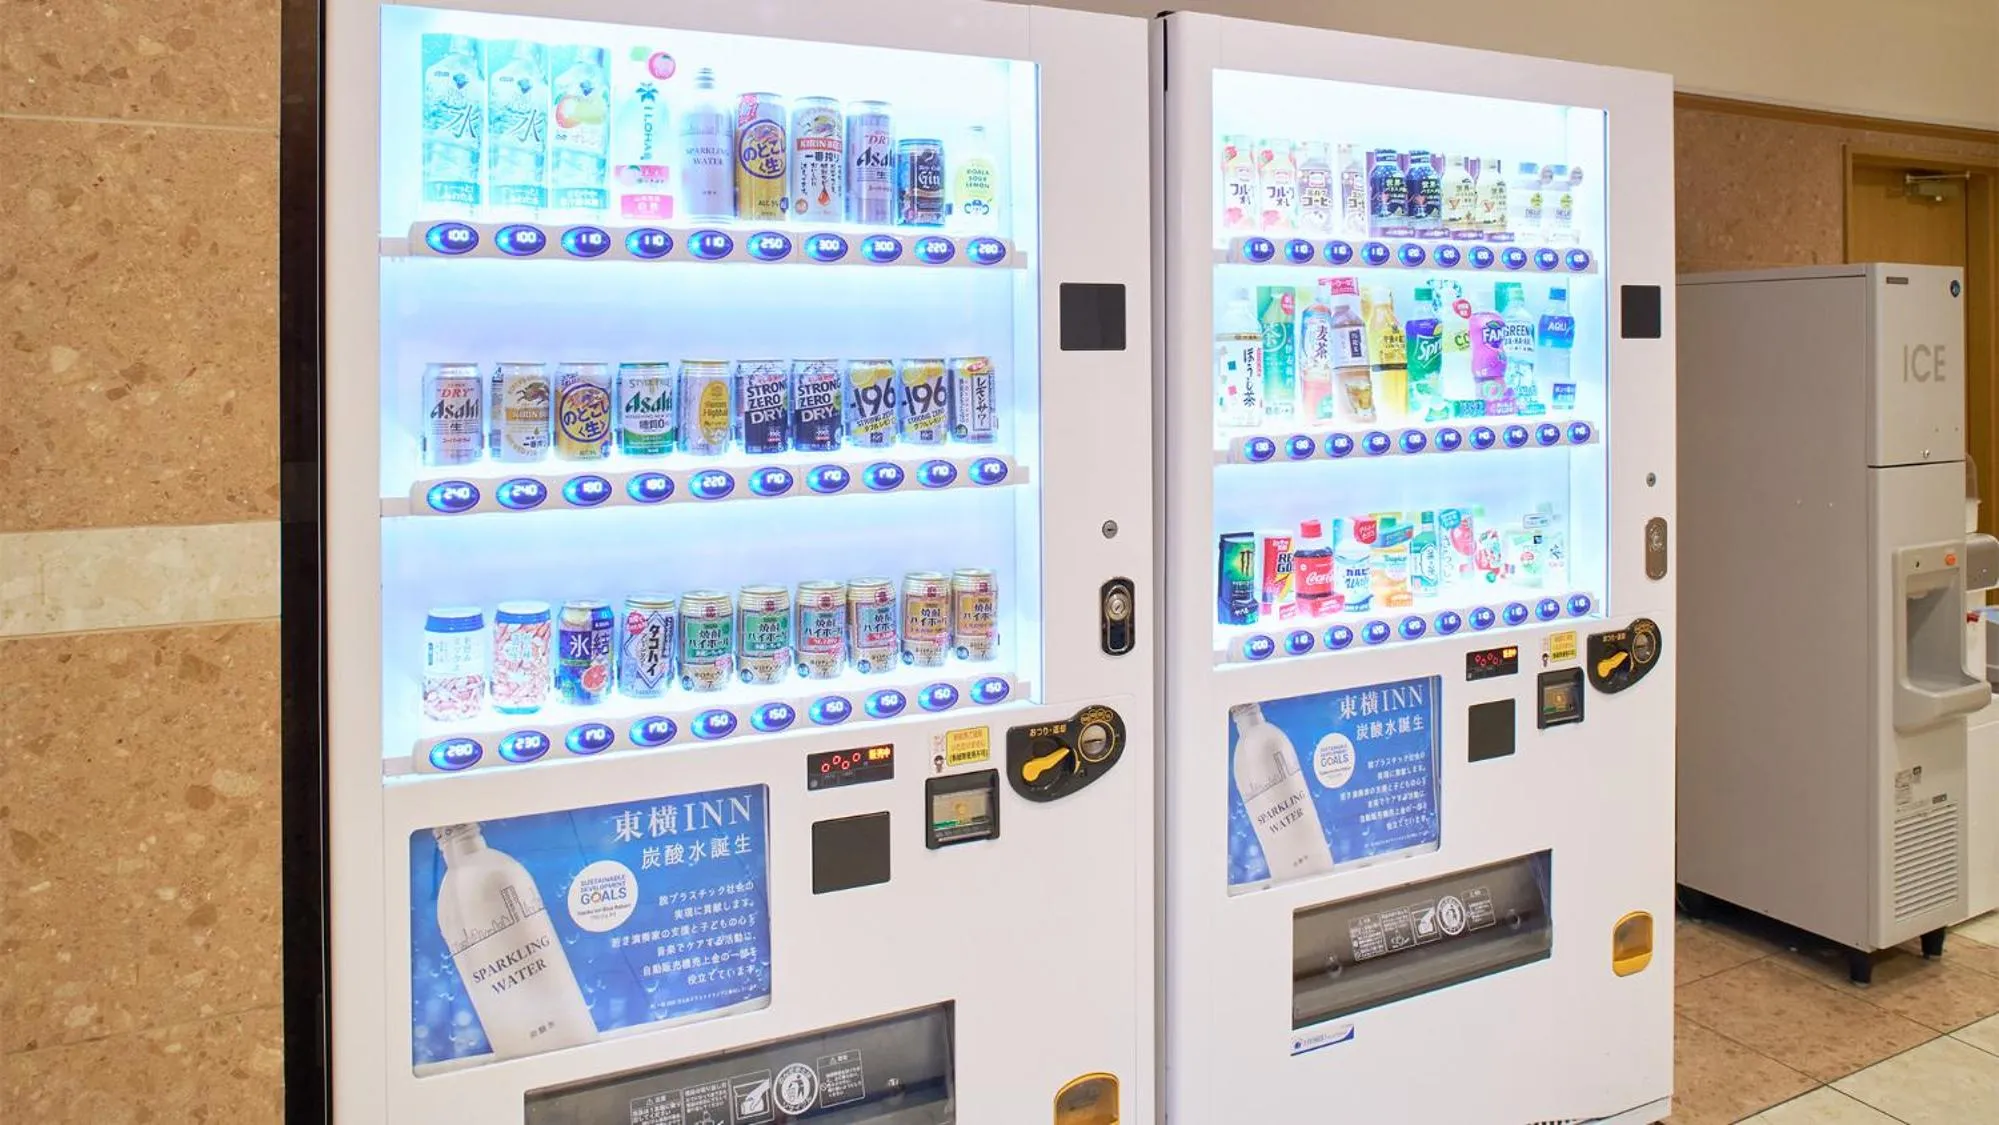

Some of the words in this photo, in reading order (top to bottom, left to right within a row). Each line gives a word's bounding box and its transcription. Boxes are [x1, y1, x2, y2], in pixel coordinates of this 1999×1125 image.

[1903, 343, 1947, 383] ICE
[430, 399, 480, 419] Asahi
[748, 393, 781, 410] ZERO
[800, 392, 831, 408] ZERO
[751, 406, 782, 425] DRY
[801, 406, 834, 423] DRY
[443, 487, 470, 500] 240
[512, 484, 538, 497] 240
[1257, 791, 1306, 825] SPARKLING
[615, 795, 752, 842] 東横INN
[1269, 807, 1304, 835] WATER
[641, 834, 753, 870] 炭酸水誕生
[580, 887, 627, 905] GOALS
[472, 935, 551, 984] SPARKLING
[491, 958, 548, 996] WATER
